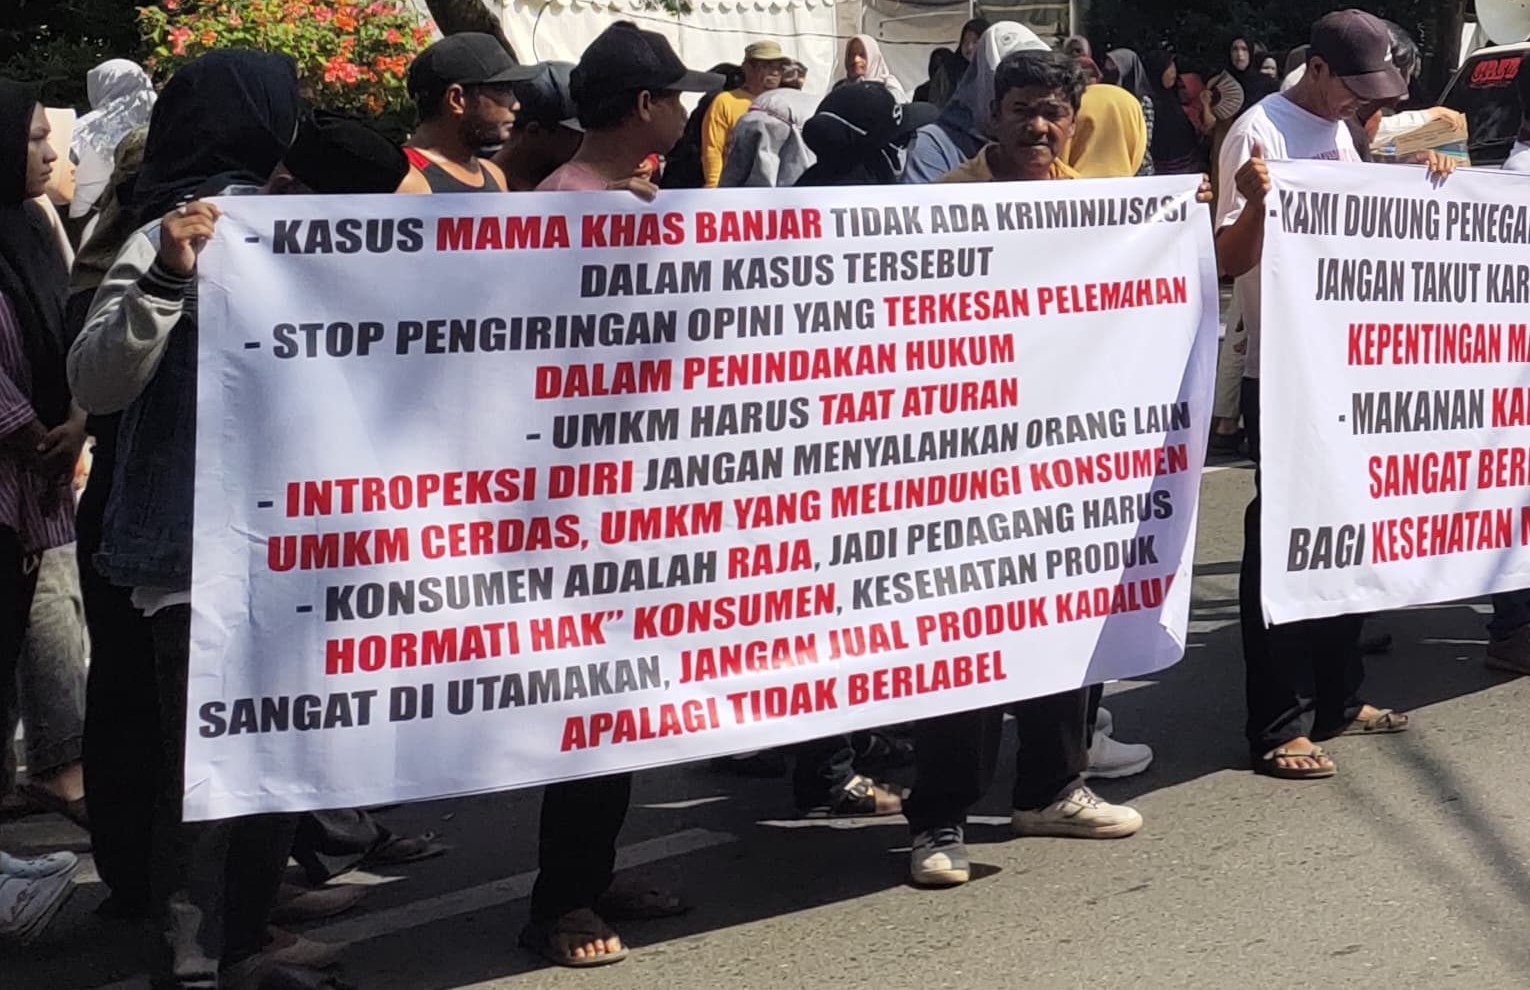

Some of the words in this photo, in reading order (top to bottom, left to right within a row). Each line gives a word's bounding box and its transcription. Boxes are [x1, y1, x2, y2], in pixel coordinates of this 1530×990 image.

[273, 218, 423, 253] KASUS
[436, 216, 569, 251] MAMA
[582, 212, 684, 247] KHAS
[696, 209, 822, 244] BANJAR
[831, 207, 921, 238] TIDAK
[931, 205, 988, 235] ADA
[1279, 190, 1339, 235] KAMI
[1344, 195, 1440, 240] DUKUNG
[581, 261, 711, 297] DALAM
[723, 254, 833, 291] KASUS
[844, 246, 994, 283] TERSEBUT
[1316, 258, 1401, 302] JANGAN
[1411, 263, 1481, 303] TAKUT
[273, 321, 383, 358] STOP
[397, 310, 676, 354] PENGIRINGAN
[688, 303, 783, 342] OPINI
[795, 298, 875, 336] YANG
[883, 286, 1027, 327] TERKESAN
[1039, 276, 1186, 315] PELEMAHAN
[1348, 324, 1500, 366] KEPENTINGAN
[535, 355, 671, 399] DALAM
[683, 342, 896, 390] PENINDAKAN
[906, 334, 1014, 372] HUKUM
[553, 407, 678, 449] UMKM
[691, 397, 809, 438] HARUS
[820, 389, 896, 425] TAAT
[903, 378, 1018, 416] ATURAN
[1352, 389, 1484, 435] MAKANAN
[286, 468, 536, 517] INTROPEKSI
[548, 461, 632, 498] DIRI
[643, 443, 782, 490] JANGAN
[794, 423, 1018, 475] MENYALAHKAN
[1026, 410, 1126, 449] ORANG
[1134, 403, 1190, 435] LAIN
[1369, 450, 1471, 499] SANGAT
[267, 528, 408, 571] UMKM
[421, 515, 588, 559] CERDAS,
[601, 501, 723, 544] UMKM
[734, 491, 820, 530] YANG
[831, 467, 1022, 518] MELINDUNGI
[1031, 444, 1187, 493] KONSUMEN
[1287, 524, 1365, 572] BAGI
[1372, 507, 1512, 564] KESEHATAN
[326, 569, 552, 622] KONSUMEN
[564, 552, 716, 597] ADALAH
[728, 540, 820, 579] RAJA,
[830, 527, 896, 566] JADI
[908, 506, 1073, 555] PEDAGANG
[1083, 490, 1172, 526] HARUS
[326, 622, 519, 675] HORMATI
[633, 584, 842, 640] KONSUMEN,
[853, 560, 1036, 609] KESEHATAN
[1047, 535, 1158, 578] PRODUK
[200, 690, 377, 738] SANGAT
[390, 683, 434, 722] DI
[448, 657, 670, 715] UTAMAKAN,
[680, 636, 816, 683] JANGAN
[828, 621, 908, 661] JUAL
[920, 596, 1047, 646] PRODUK
[561, 698, 719, 751] APALAGI
[728, 678, 838, 722] TIDAK
[849, 650, 1006, 706] BERLABEL
